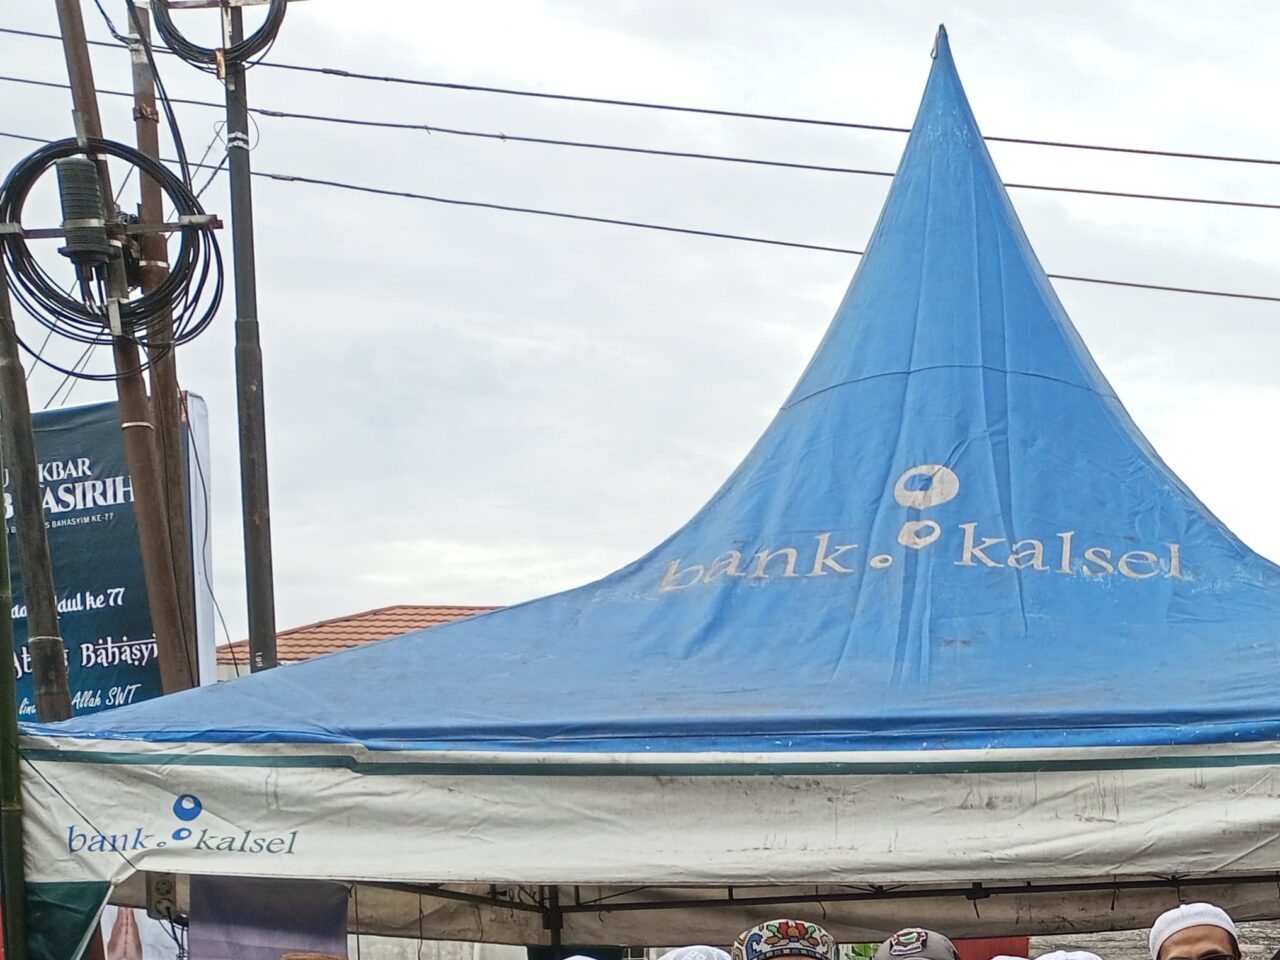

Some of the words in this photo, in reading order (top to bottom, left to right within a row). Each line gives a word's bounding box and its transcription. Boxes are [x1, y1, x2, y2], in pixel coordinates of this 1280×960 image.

[37, 457, 93, 482] KBAR
[40, 475, 135, 514] ASIRIH
[654, 532, 860, 592] bank
[954, 521, 1193, 581] kalsel
[86, 591, 106, 610] ke
[107, 587, 125, 606] 77
[71, 690, 102, 709] Allah
[105, 683, 142, 706] SWT
[67, 825, 155, 853] bank
[192, 828, 298, 855] kalsel
